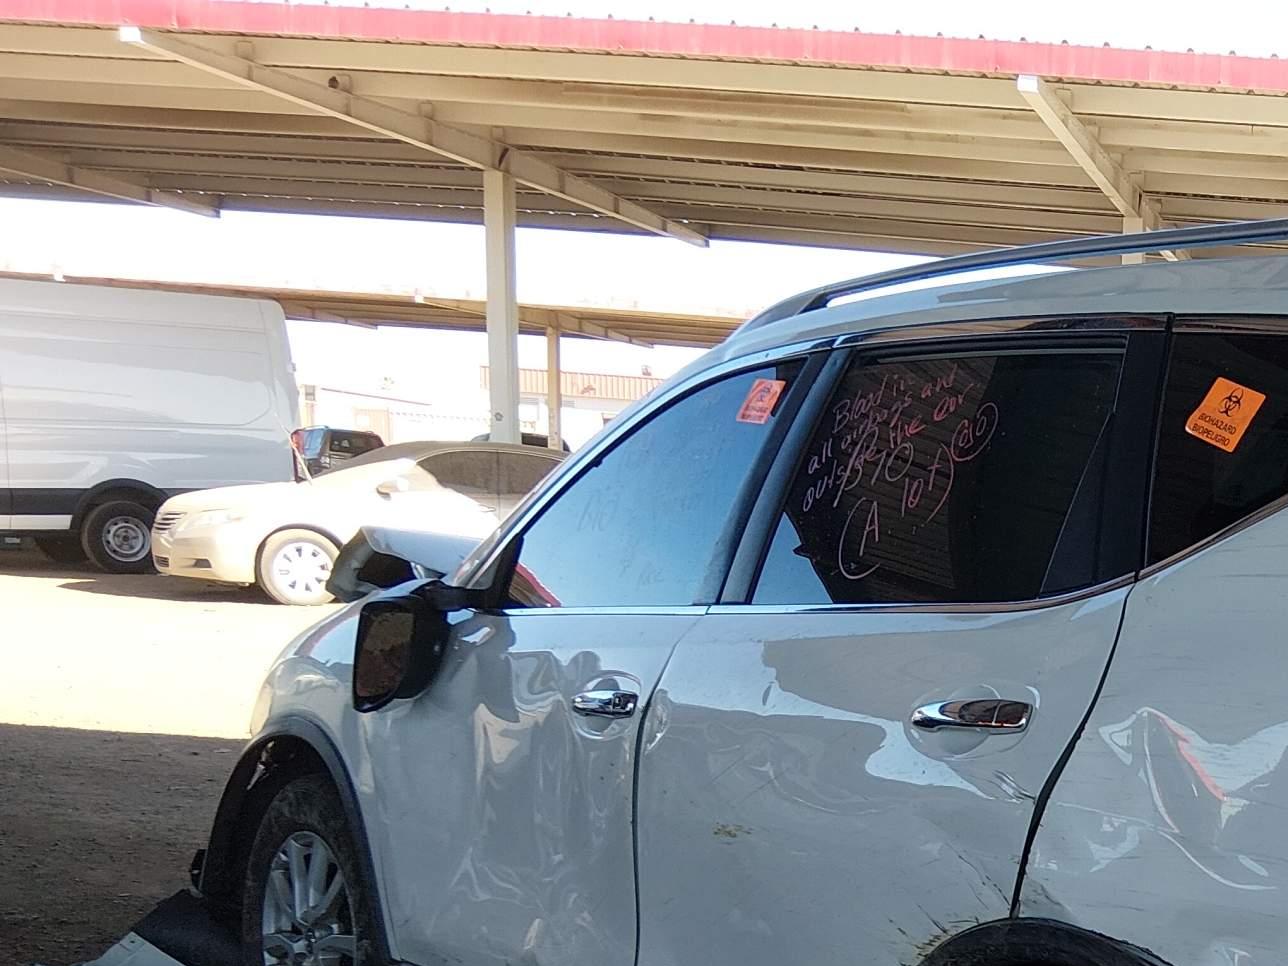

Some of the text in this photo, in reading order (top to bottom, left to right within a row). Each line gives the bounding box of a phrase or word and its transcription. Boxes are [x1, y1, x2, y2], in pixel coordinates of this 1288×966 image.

[1191, 423, 1231, 447] BIOPELIGRO
[1198, 412, 1237, 435] BIOHAZARD
[807, 438, 833, 475] all
